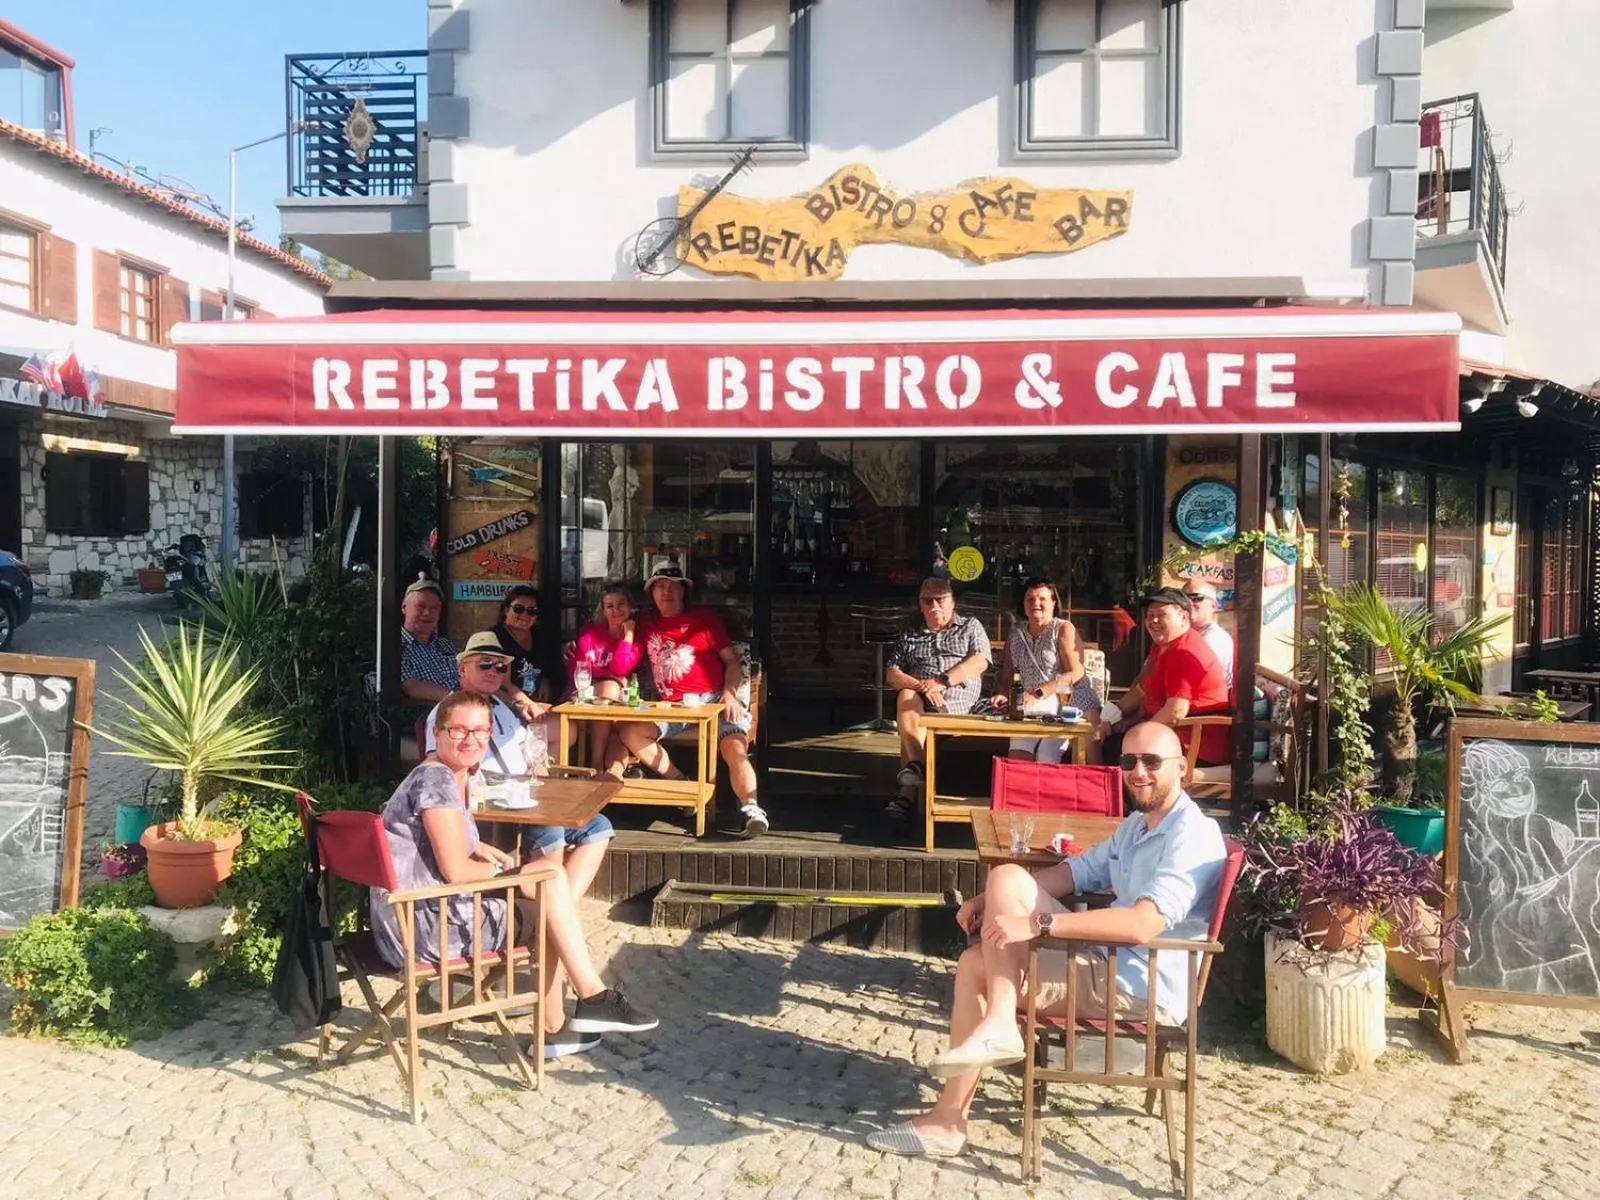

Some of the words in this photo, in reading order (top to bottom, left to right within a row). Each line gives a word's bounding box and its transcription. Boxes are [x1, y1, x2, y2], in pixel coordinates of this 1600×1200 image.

[691, 221, 848, 277] REBETIKA
[804, 175, 916, 230] BISTRO
[958, 183, 1037, 238] CAFE
[1054, 195, 1128, 246] BAR
[1014, 352, 1064, 410] &
[1094, 351, 1298, 409] CAFE
[447, 534, 477, 555] COLD
[478, 511, 529, 543] DRINKS
[1178, 561, 1235, 581] REAKFAS
